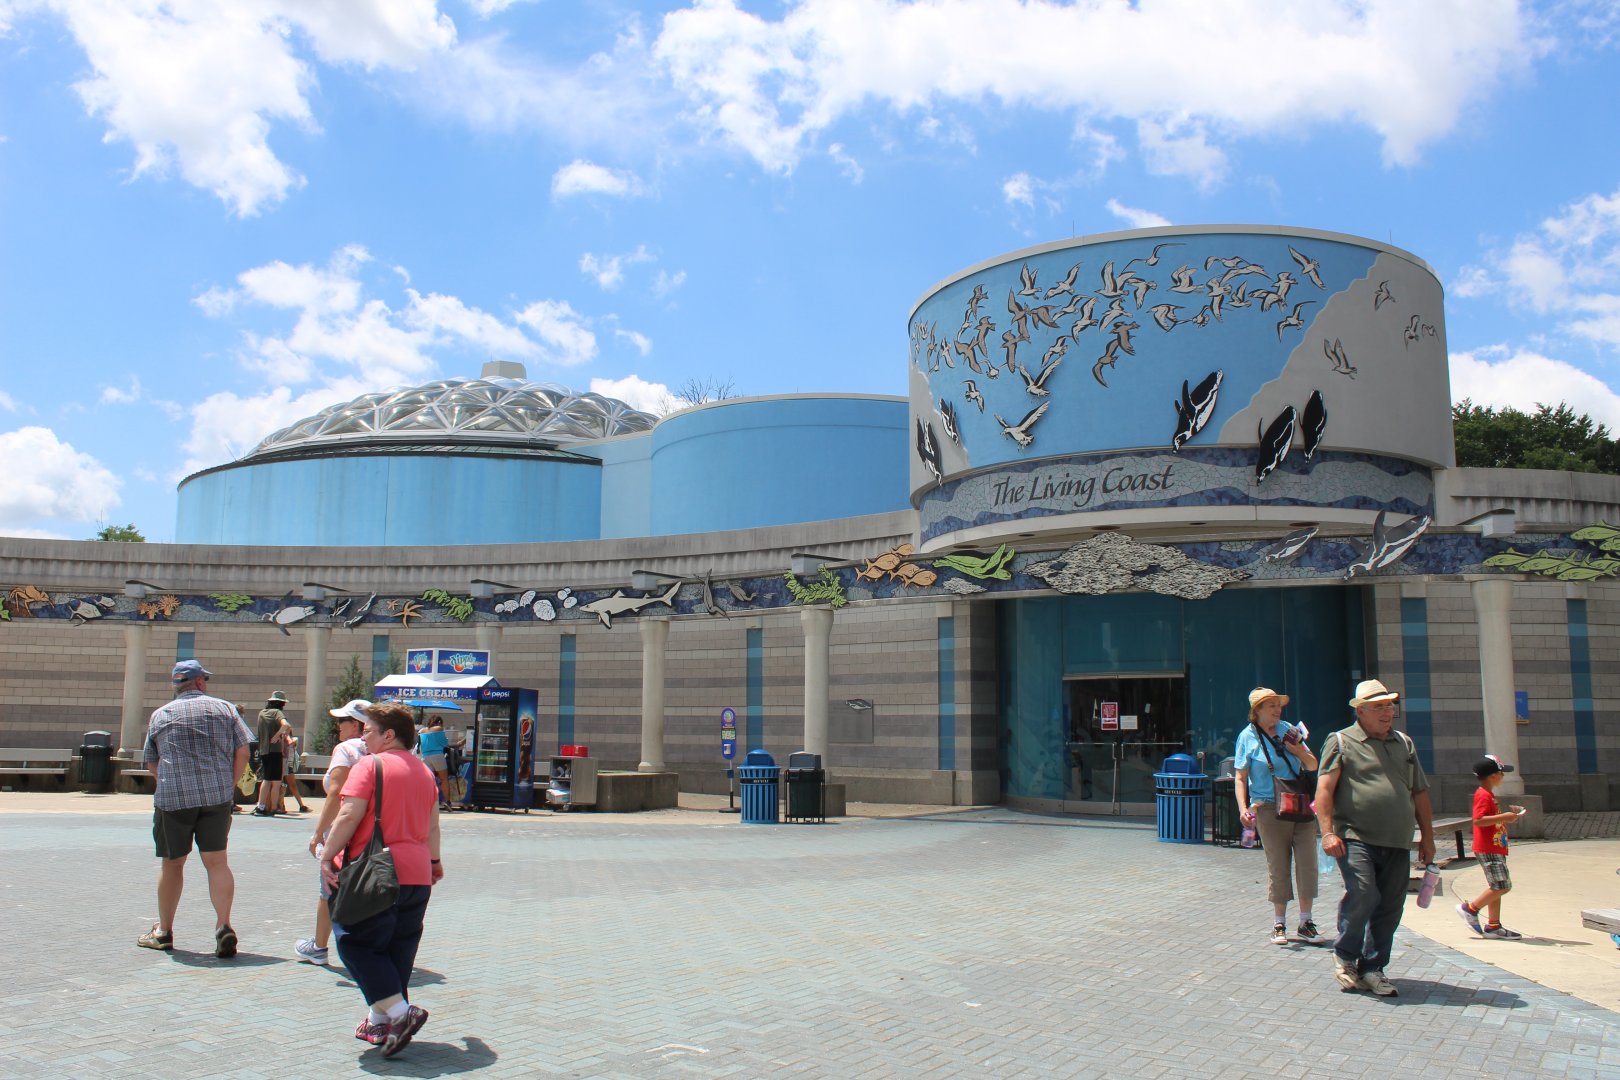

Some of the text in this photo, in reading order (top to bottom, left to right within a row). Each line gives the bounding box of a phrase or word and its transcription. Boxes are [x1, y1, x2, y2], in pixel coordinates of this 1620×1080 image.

[993, 464, 1175, 507] The Living Coast
[398, 688, 458, 698] ICE CREAM
